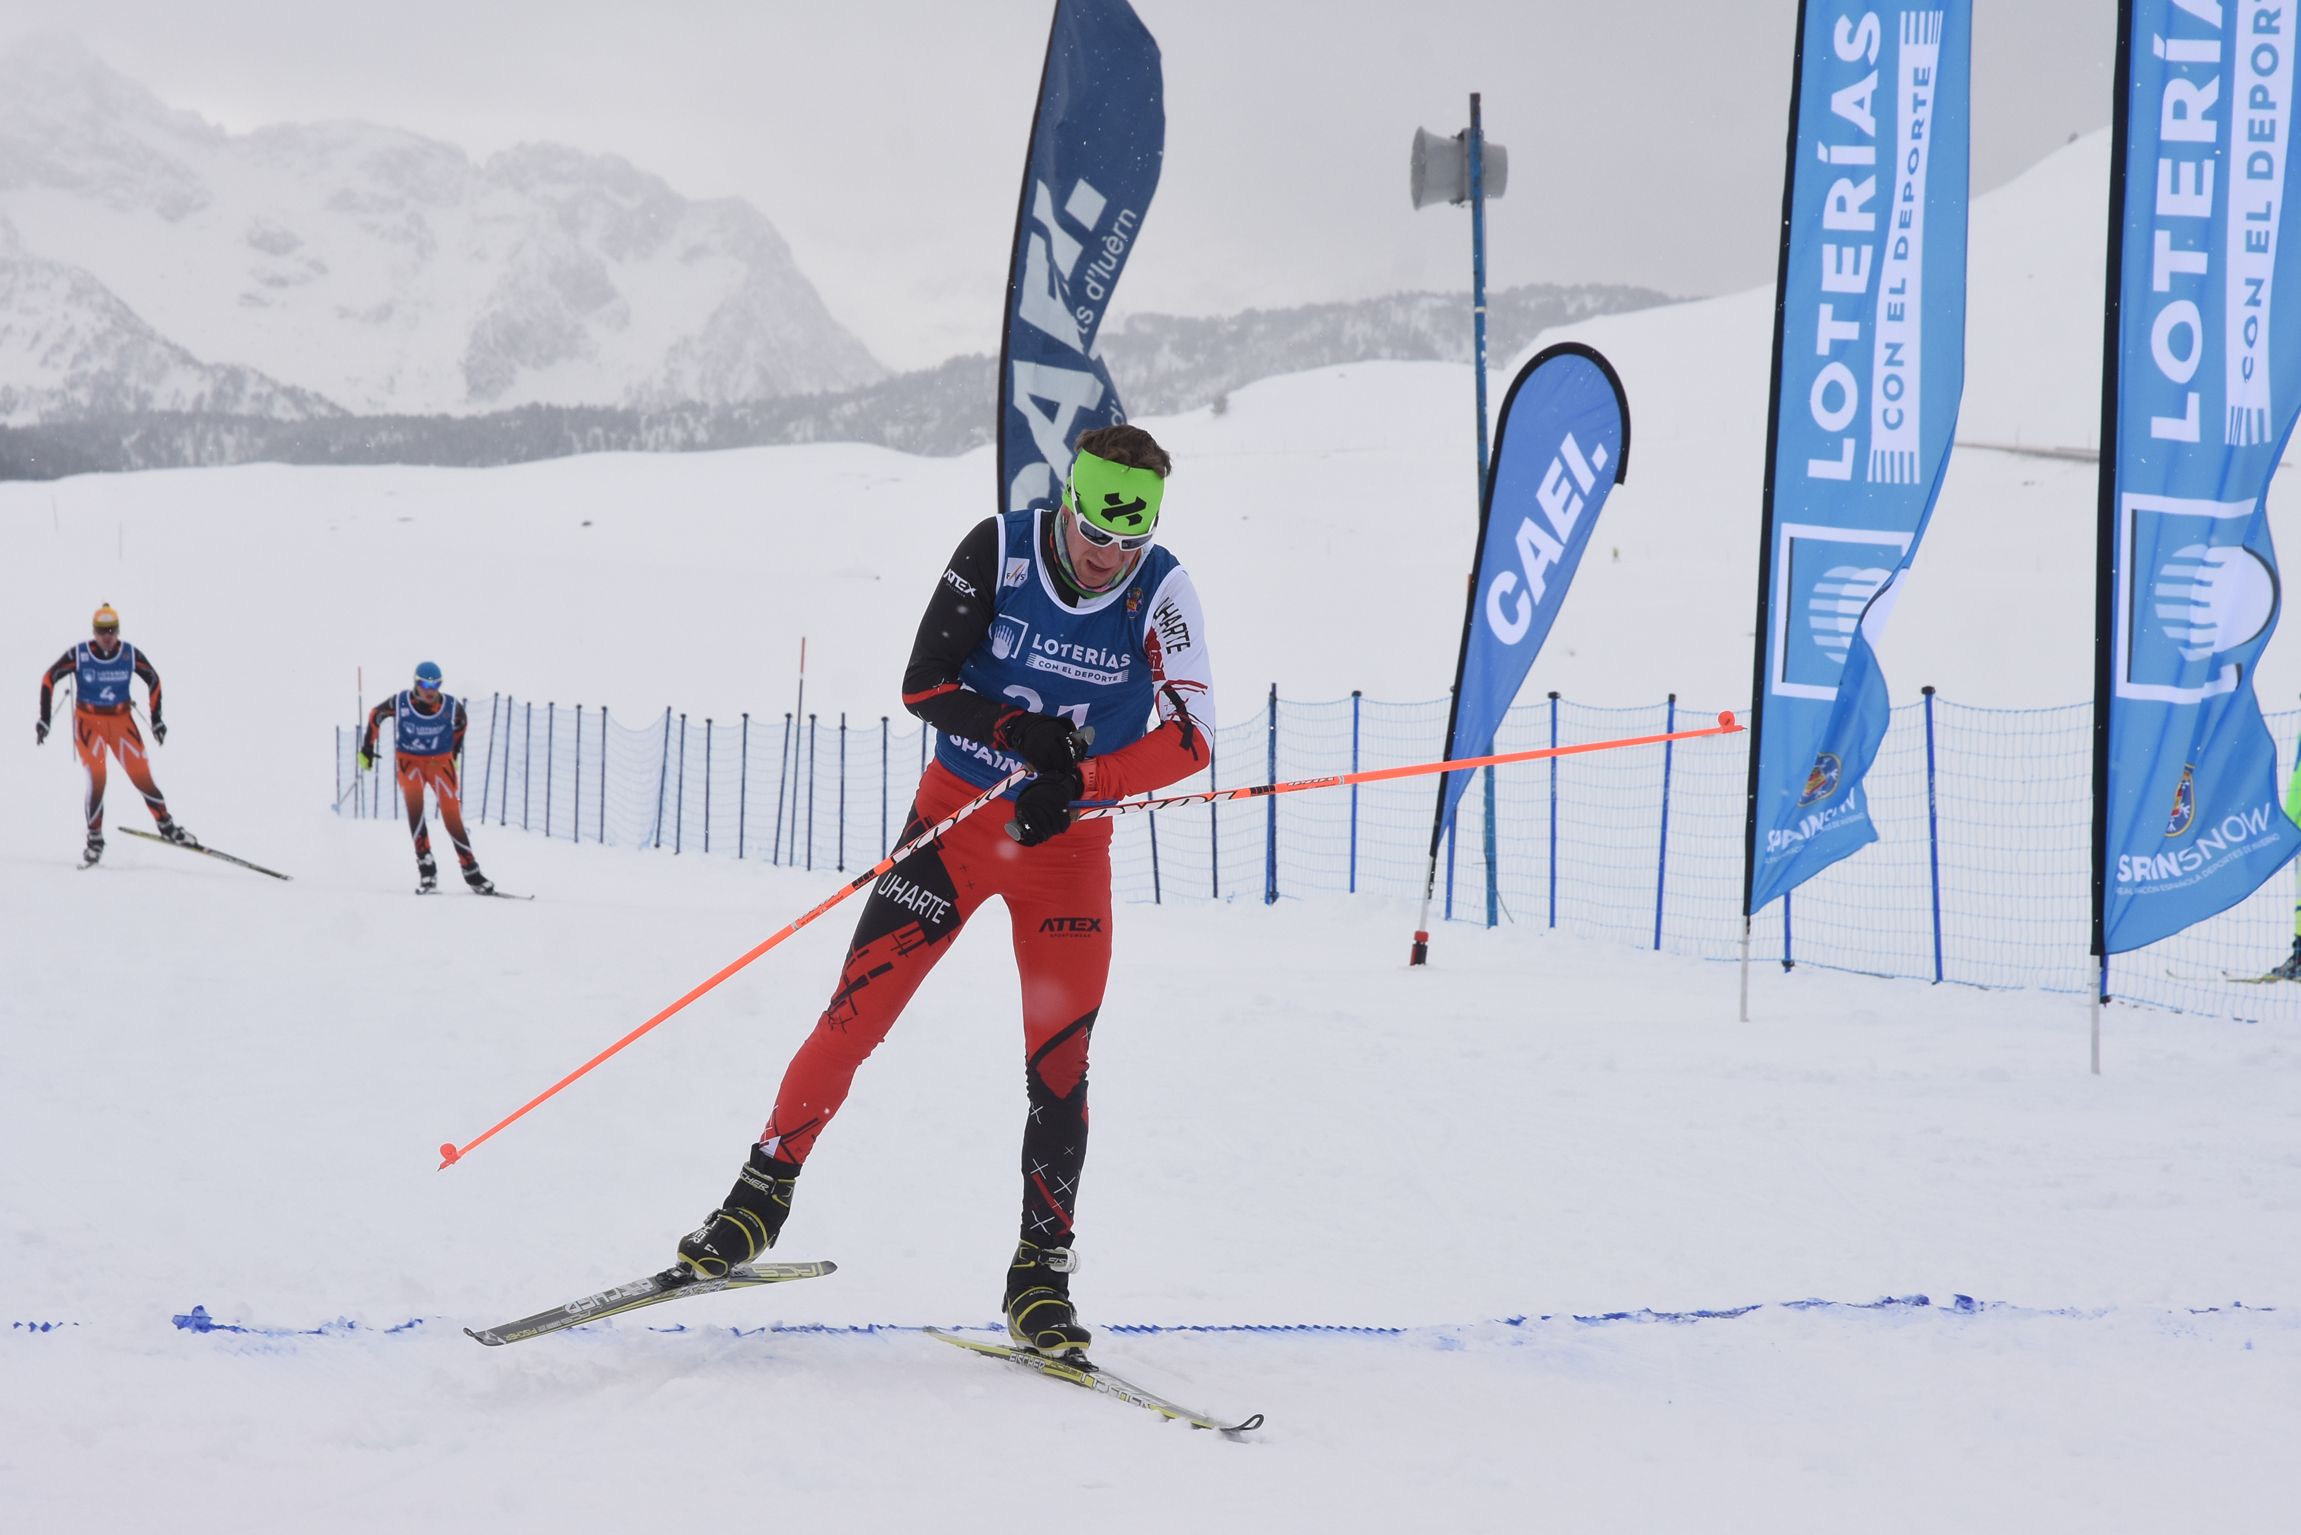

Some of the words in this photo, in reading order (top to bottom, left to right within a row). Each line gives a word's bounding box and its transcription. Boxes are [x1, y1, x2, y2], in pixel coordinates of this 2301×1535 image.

[2246, 0, 2282, 181] DEPOR
[1893, 66, 1931, 261] DEPORTE
[1807, 11, 1881, 480] LOTERÍAS
[2246, 201, 2272, 253] EL
[1886, 278, 1906, 322] EL
[2242, 278, 2265, 384] CON
[1882, 338, 1905, 430] CON
[1486, 431, 1609, 645] CAEI.
[1032, 633, 1131, 669] LOTERÍAS
[1153, 596, 1191, 655] UHARTE
[99, 686, 116, 701] 4
[1038, 660, 1059, 671] CON
[1061, 666, 1072, 675] EL
[1074, 669, 1119, 683] DEPORTE
[877, 871, 951, 924] UHARTE
[1038, 917, 1102, 933] ATEX
